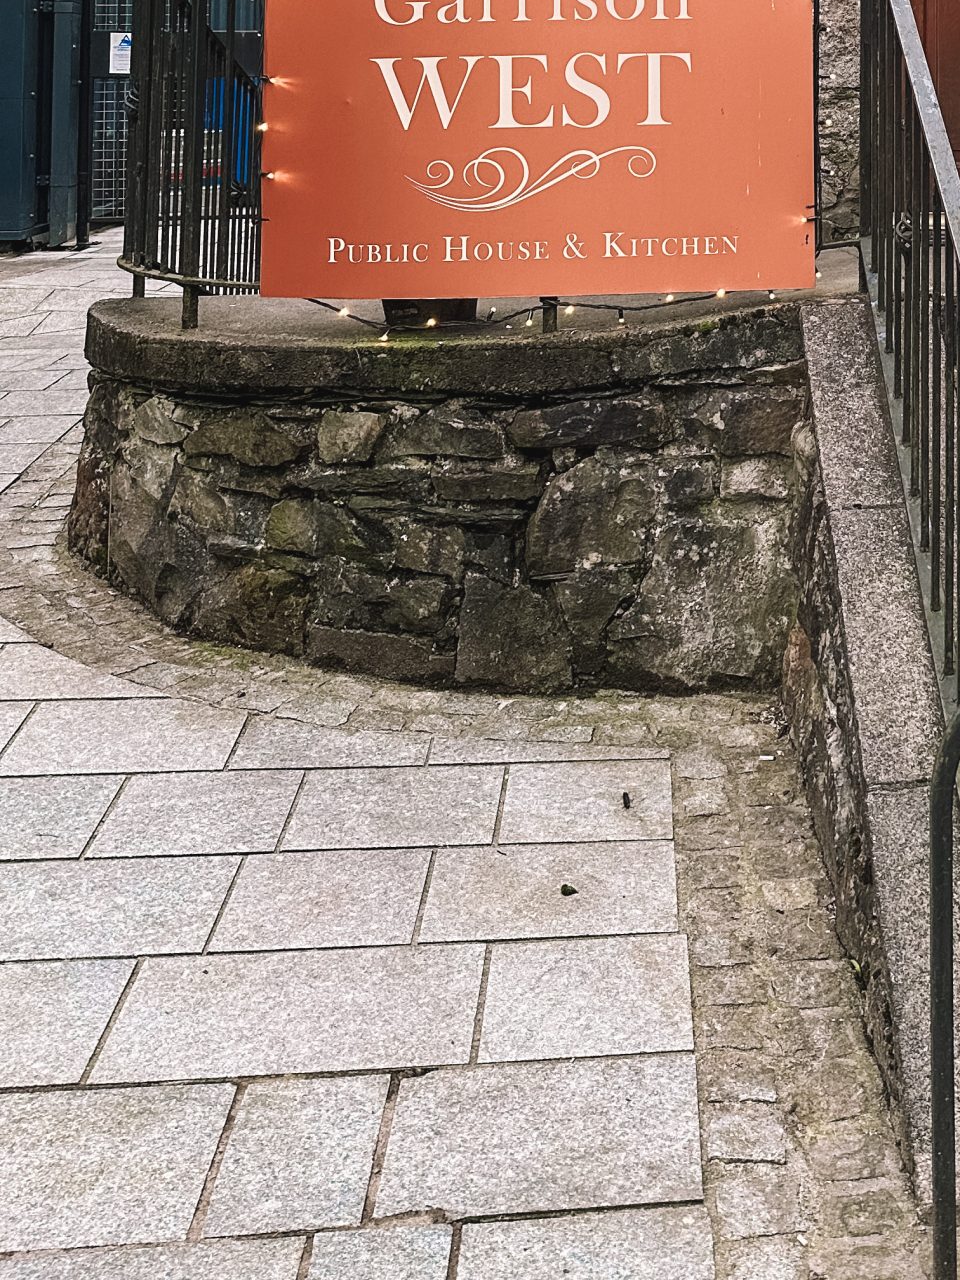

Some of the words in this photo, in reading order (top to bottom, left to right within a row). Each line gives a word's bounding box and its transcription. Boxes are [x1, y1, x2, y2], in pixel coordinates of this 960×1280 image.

[369, 52, 692, 131] WEST
[327, 237, 429, 265] PUBLIC
[442, 235, 550, 263] HOUSE
[563, 233, 589, 261] &
[602, 231, 740, 259] KITCHEN
